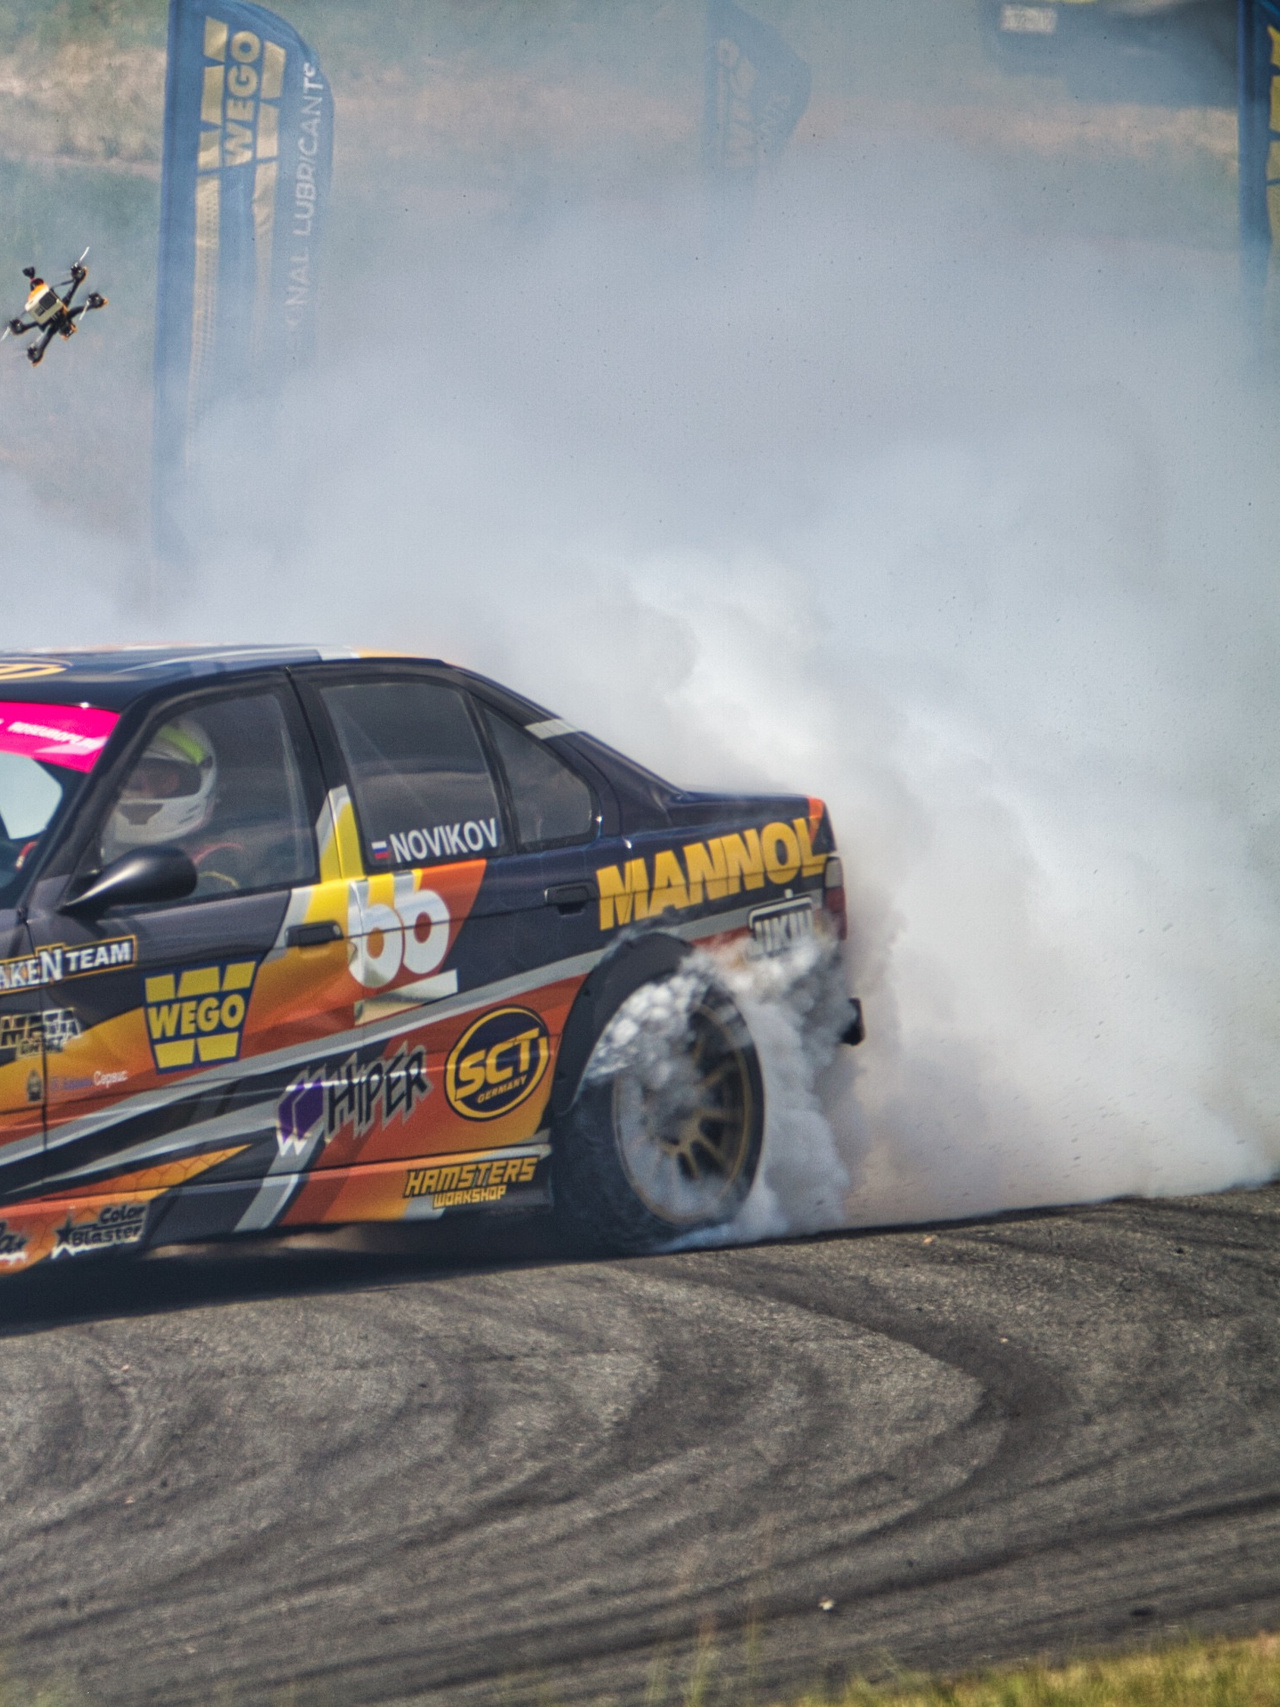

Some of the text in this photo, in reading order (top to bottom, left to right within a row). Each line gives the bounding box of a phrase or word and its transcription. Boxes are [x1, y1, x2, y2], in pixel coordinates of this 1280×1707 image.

[224, 30, 261, 168] WEGO
[389, 817, 498, 863] NOVIKOV
[596, 817, 827, 931] MANNOL
[347, 869, 451, 989] 66
[65, 941, 132, 972] TEAM
[147, 994, 246, 1040] WEGO
[456, 1027, 541, 1101] SCT
[323, 1040, 434, 1142] HIPER
[477, 1075, 528, 1103] GERMANY
[404, 1157, 540, 1198] HAMSTERS
[433, 1185, 507, 1208] WORKSHOP
[72, 1225, 143, 1246] Blaster
[100, 1206, 146, 1224] Color
